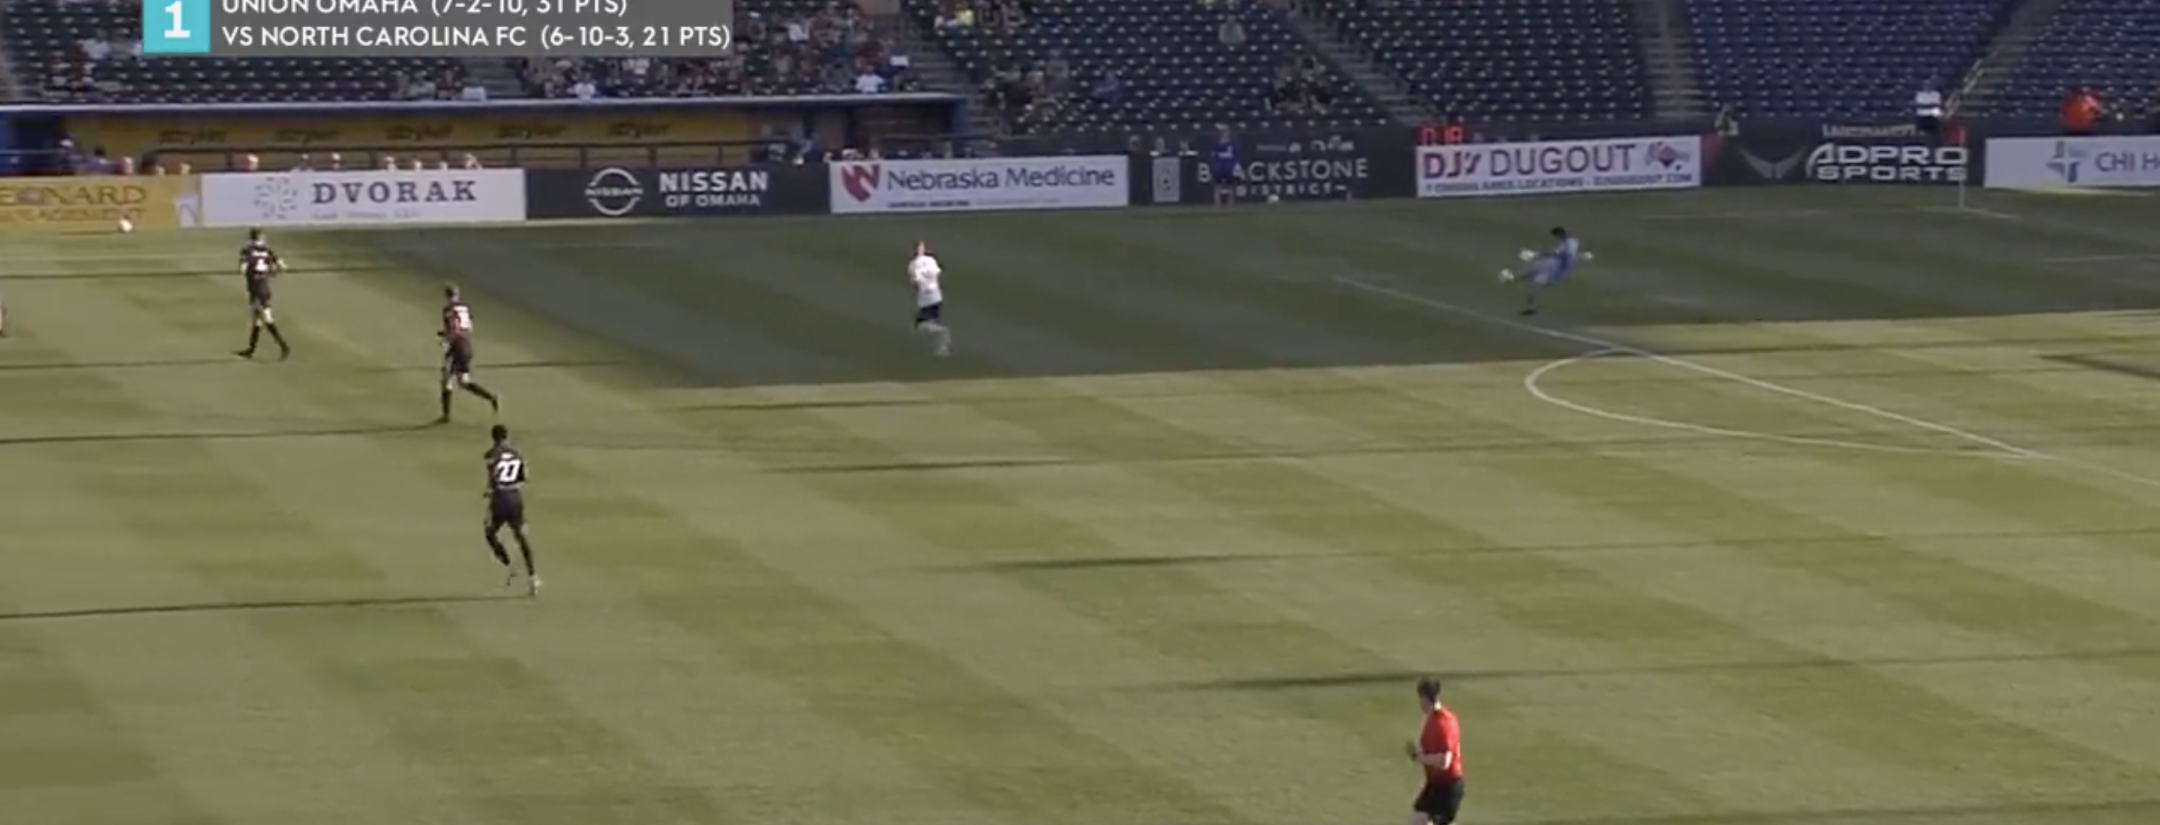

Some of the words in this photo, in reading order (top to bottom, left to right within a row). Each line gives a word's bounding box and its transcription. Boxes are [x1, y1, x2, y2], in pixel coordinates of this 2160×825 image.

[1197, 157, 1370, 183] BACKSTONE
[1489, 143, 1637, 177] DUGOUT
[1806, 142, 1968, 174] ADPRO
[2094, 151, 2136, 173] CHI
[658, 170, 769, 192] NISSAN
[887, 169, 1000, 192] Nebraska
[1004, 165, 1116, 188] Medicine
[1816, 165, 1968, 181] SPORTS
[311, 180, 478, 205] DVORAK
[665, 195, 691, 208] OF
[695, 193, 761, 207] OMAHA
[497, 459, 521, 482] 27
